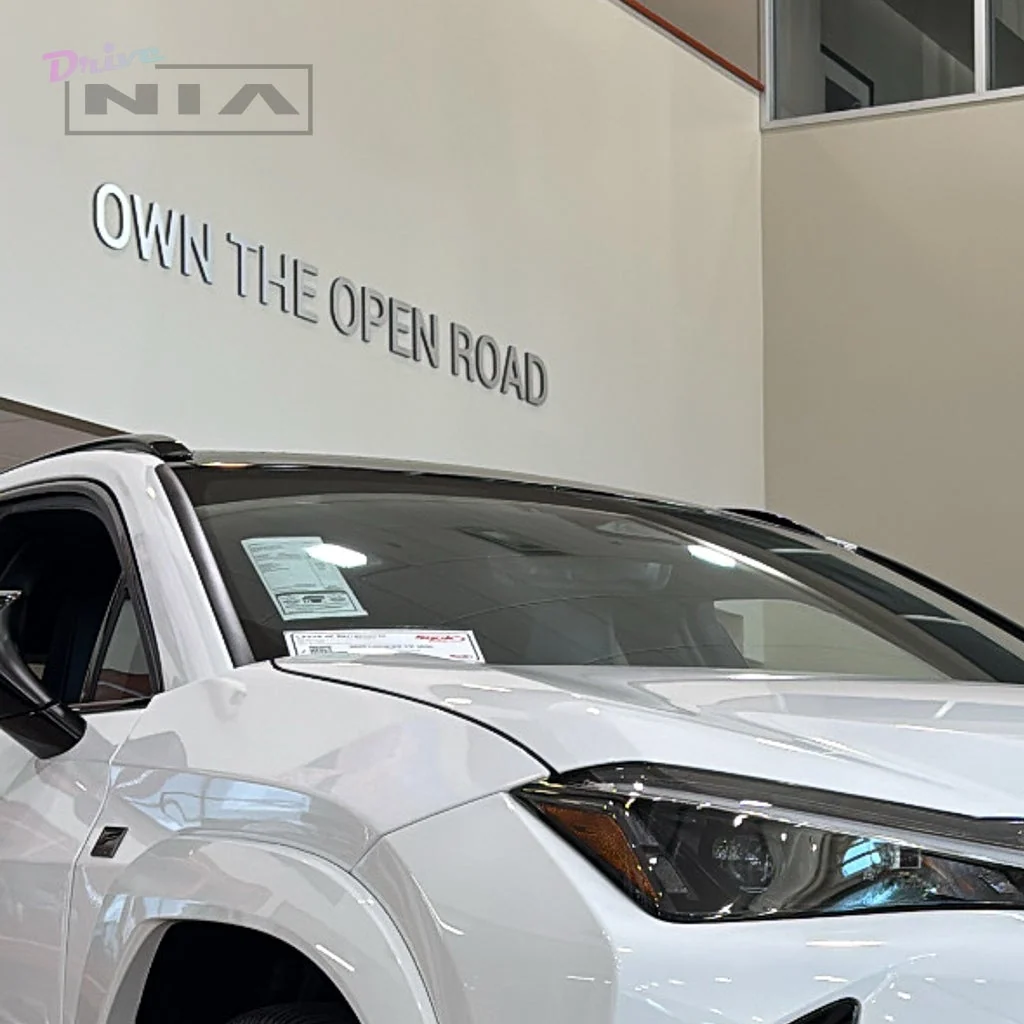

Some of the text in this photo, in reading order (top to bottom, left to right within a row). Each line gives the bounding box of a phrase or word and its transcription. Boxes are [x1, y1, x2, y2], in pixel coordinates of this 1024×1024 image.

[93, 182, 548, 408] OWN THE OPEN ROAD
